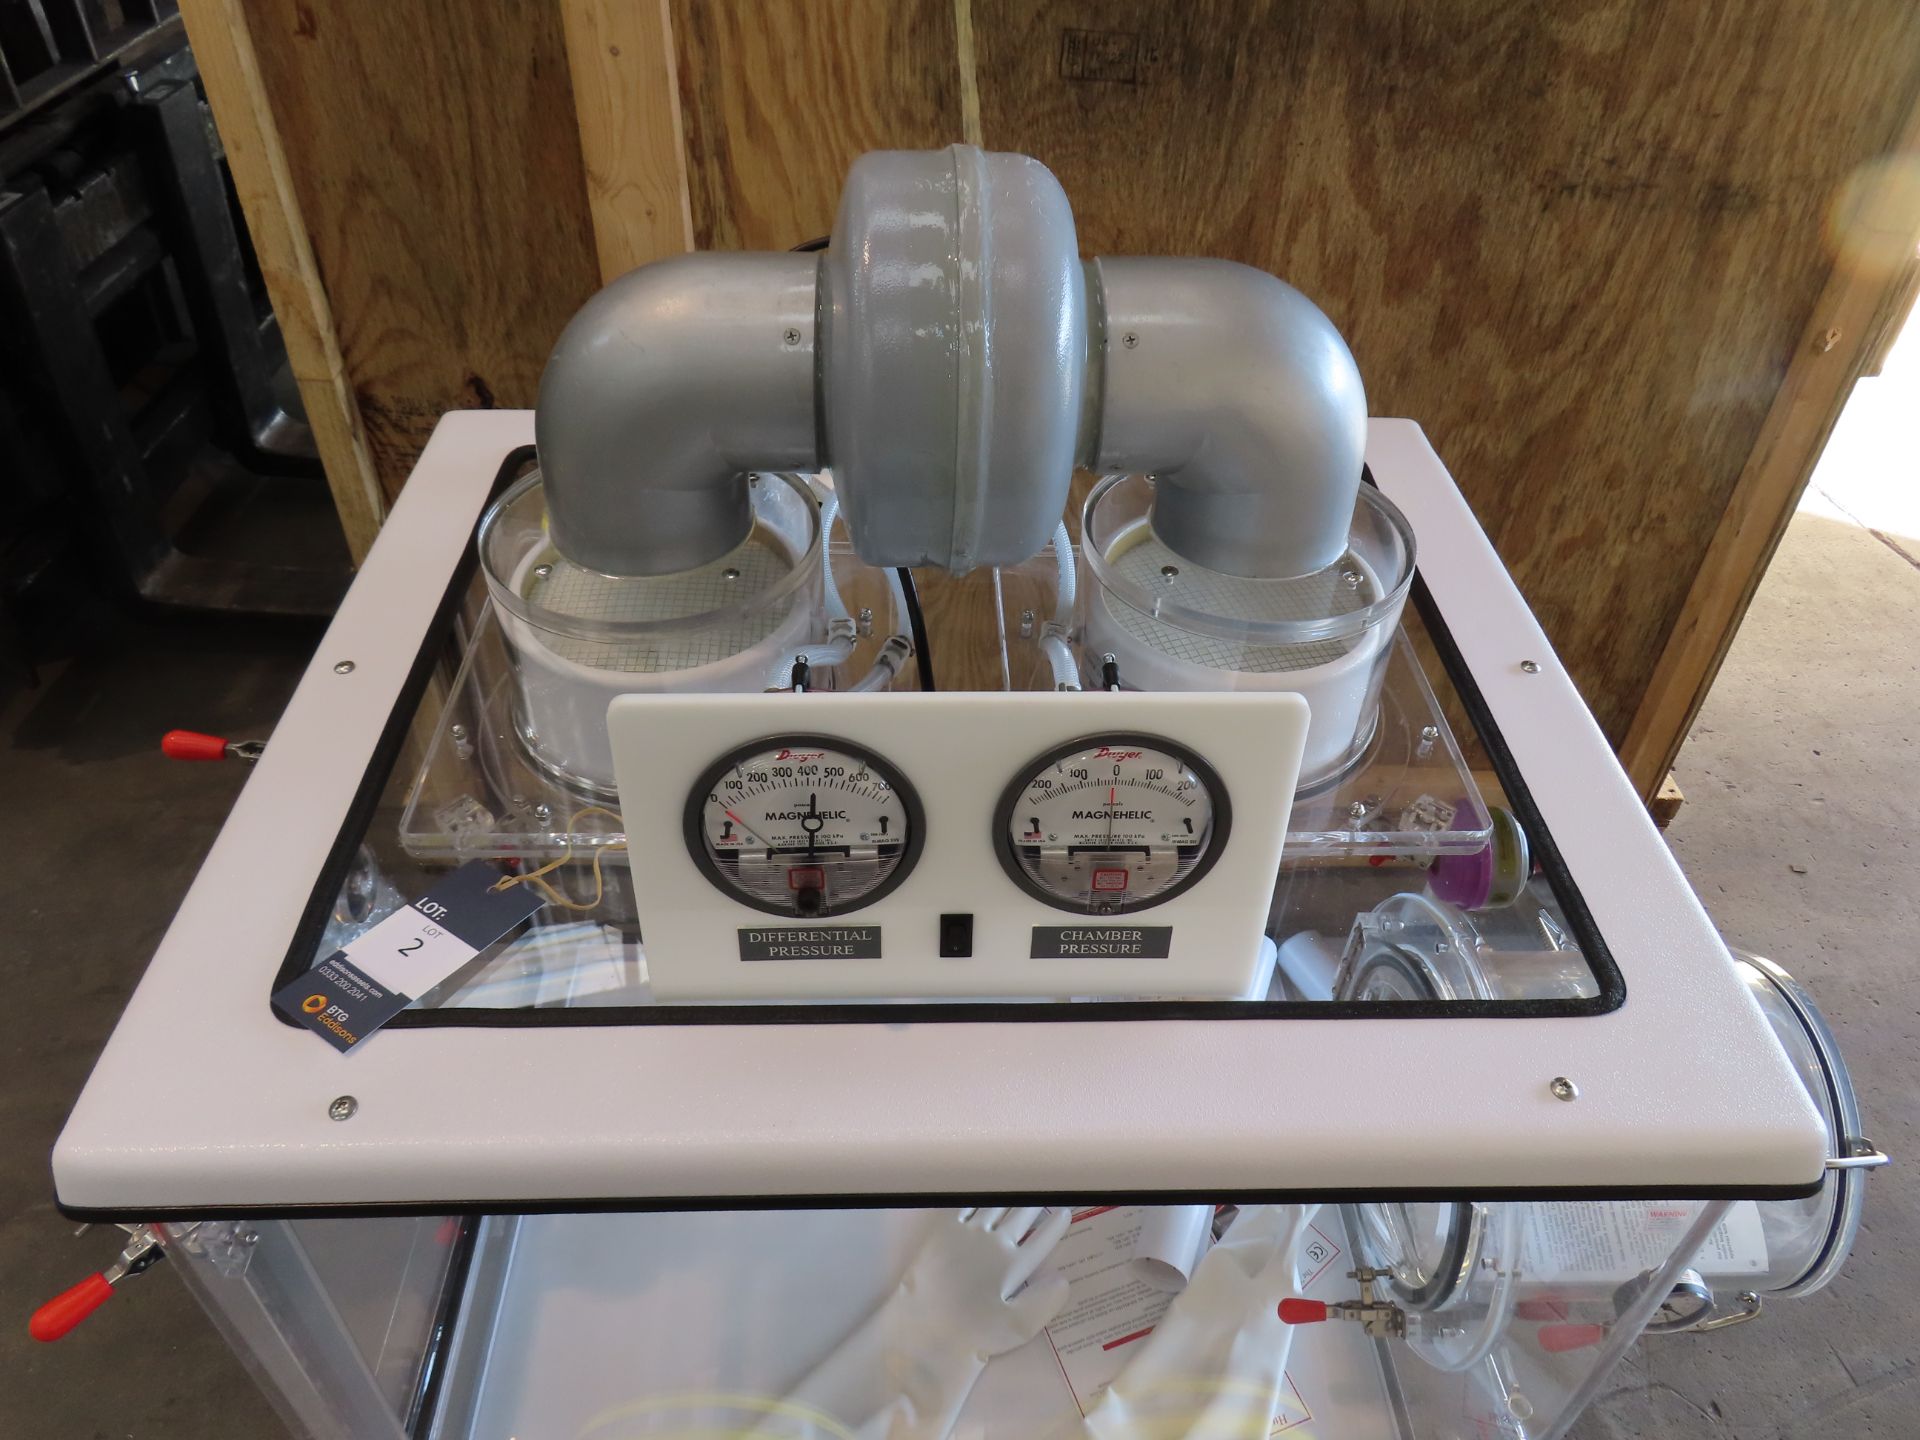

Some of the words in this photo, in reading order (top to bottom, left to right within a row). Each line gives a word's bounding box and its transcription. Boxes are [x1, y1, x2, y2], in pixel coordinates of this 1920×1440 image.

[710, 794, 718, 803] 0
[724, 780, 743, 790] 100
[746, 772, 768, 783] 200
[771, 767, 793, 778] 300
[797, 765, 818, 776] 400
[824, 767, 845, 778] 500
[848, 773, 869, 783] 600
[1032, 779, 1052, 789] 200
[1069, 768, 1088, 780] 100
[1113, 764, 1120, 776] 0
[1145, 768, 1164, 780] 100
[1176, 780, 1198, 791] 200
[1071, 810, 1152, 820] MAGNEHELIC
[415, 897, 448, 920] LOT:
[422, 925, 444, 939] LOT
[748, 930, 872, 943] DIFFERENTIAL
[1059, 930, 1143, 941] CHAMBER
[398, 937, 424, 957] 2
[769, 945, 855, 957] PRESSURE
[1059, 944, 1142, 954] PRESSURE
[319, 965, 339, 981] 0333
[334, 977, 352, 990] 200
[347, 986, 368, 1002] 2041
[326, 1005, 349, 1022] BTG
[317, 1013, 357, 1044] Eddisons
